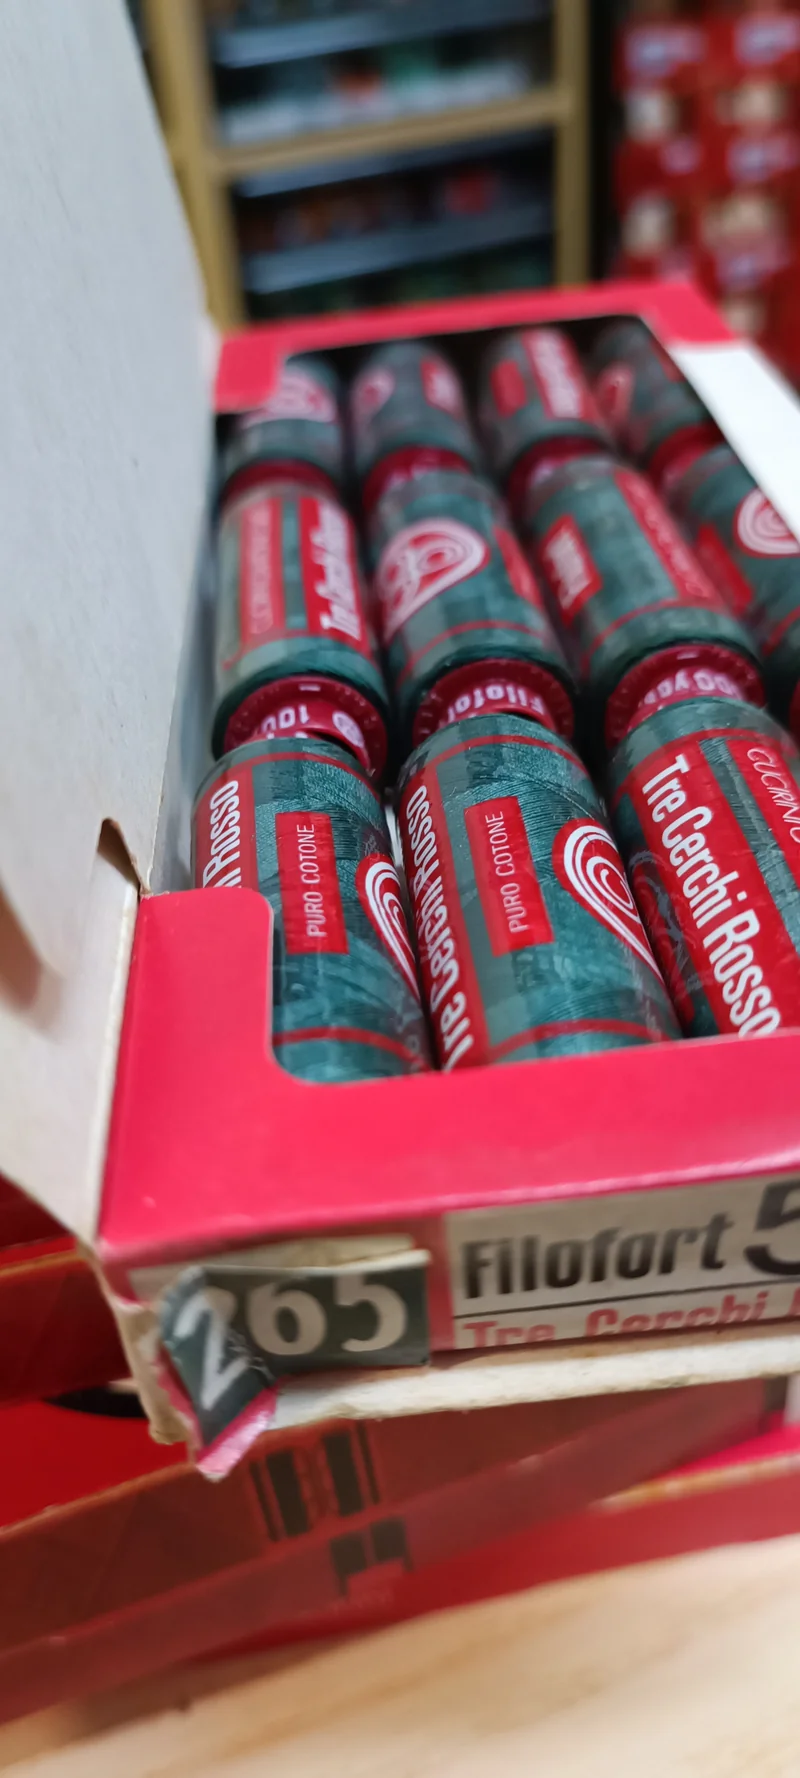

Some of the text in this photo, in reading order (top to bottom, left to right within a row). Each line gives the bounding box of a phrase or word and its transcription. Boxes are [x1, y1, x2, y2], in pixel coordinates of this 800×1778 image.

[202, 779, 241, 888] Rosso
[296, 823, 328, 938] PURO COTONE
[405, 784, 440, 902] Rosso
[484, 810, 530, 934] PURO COTONE
[642, 753, 781, 1039] Tre Cerchi Rosso
[460, 1211, 735, 1300] Filofort
[172, 1273, 408, 1413] 265
